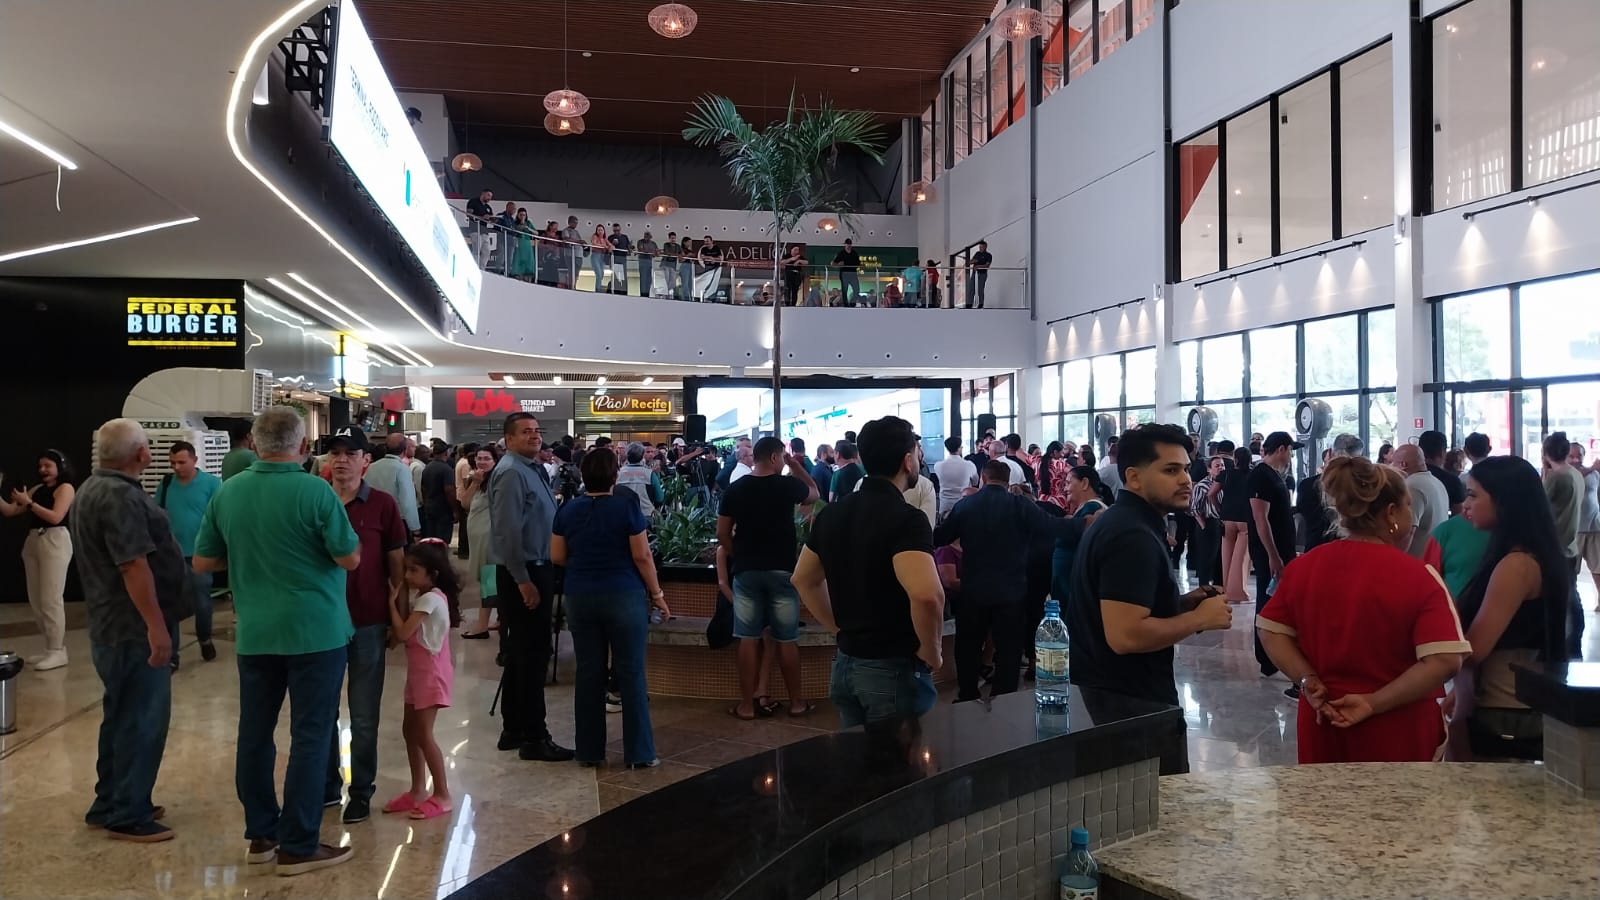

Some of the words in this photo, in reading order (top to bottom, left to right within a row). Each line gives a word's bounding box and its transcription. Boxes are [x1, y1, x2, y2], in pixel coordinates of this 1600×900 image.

[127, 303, 237, 314] FEDERAL
[127, 314, 237, 334] BURGER
[595, 395, 622, 411] Pão
[631, 398, 668, 409] Recife
[335, 428, 352, 437] LA
